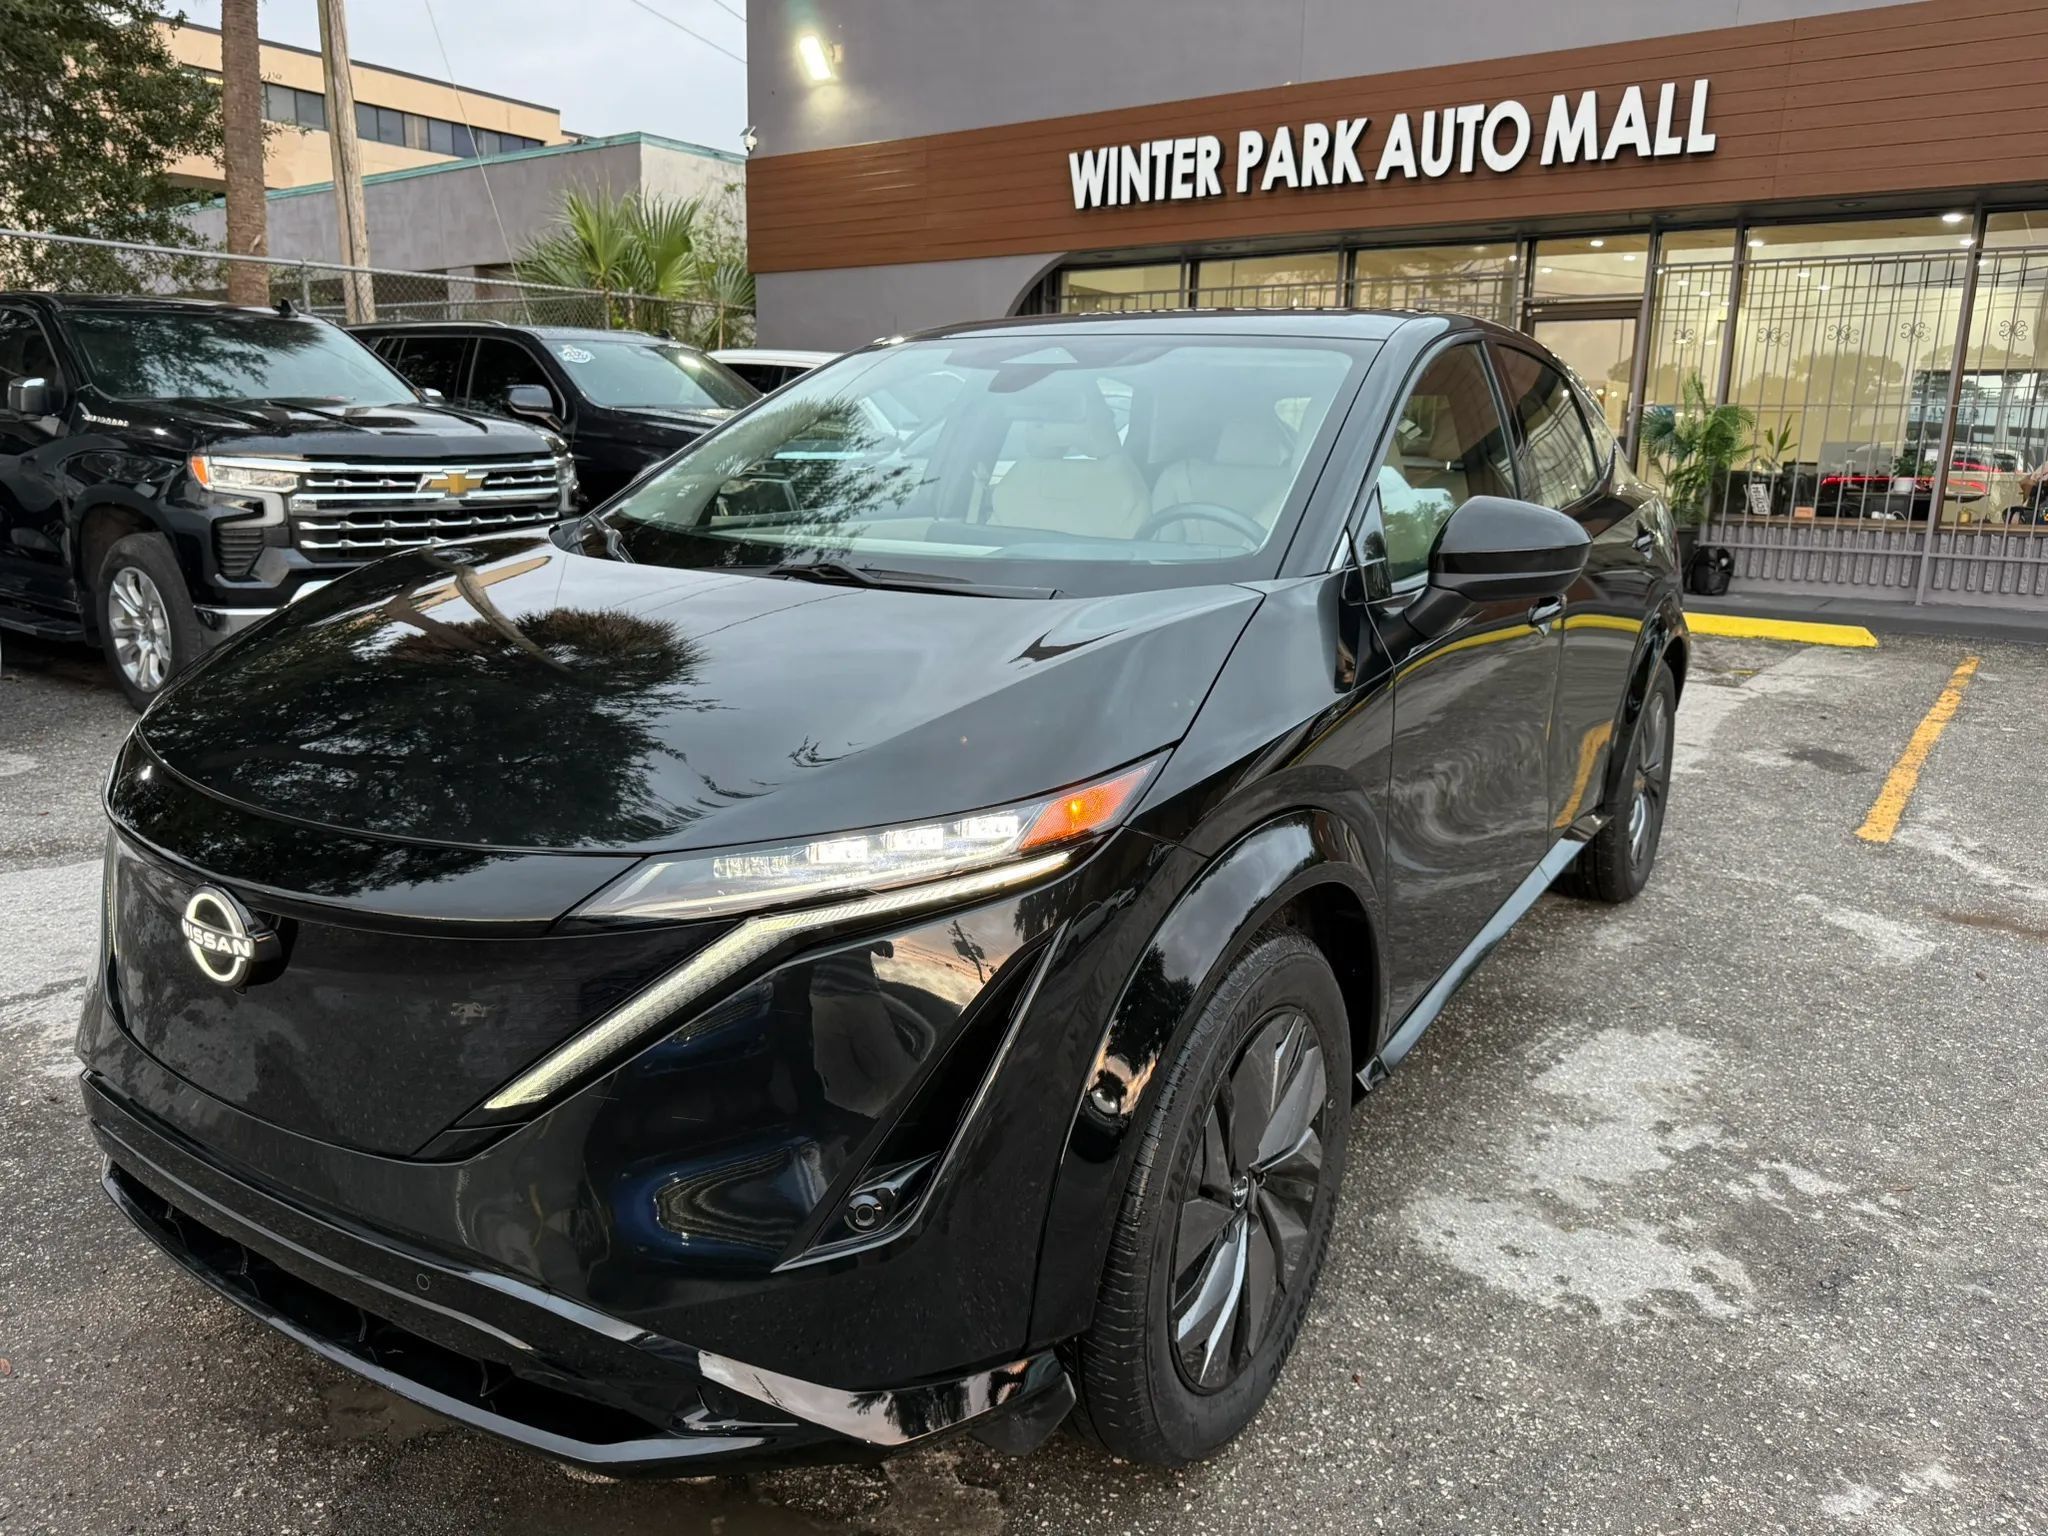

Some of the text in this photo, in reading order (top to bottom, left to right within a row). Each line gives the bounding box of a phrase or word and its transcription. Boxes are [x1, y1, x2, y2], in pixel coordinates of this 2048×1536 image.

[1068, 79, 1717, 210] WINTER PARK AUTO MALL
[182, 918, 252, 958] NISSAN
